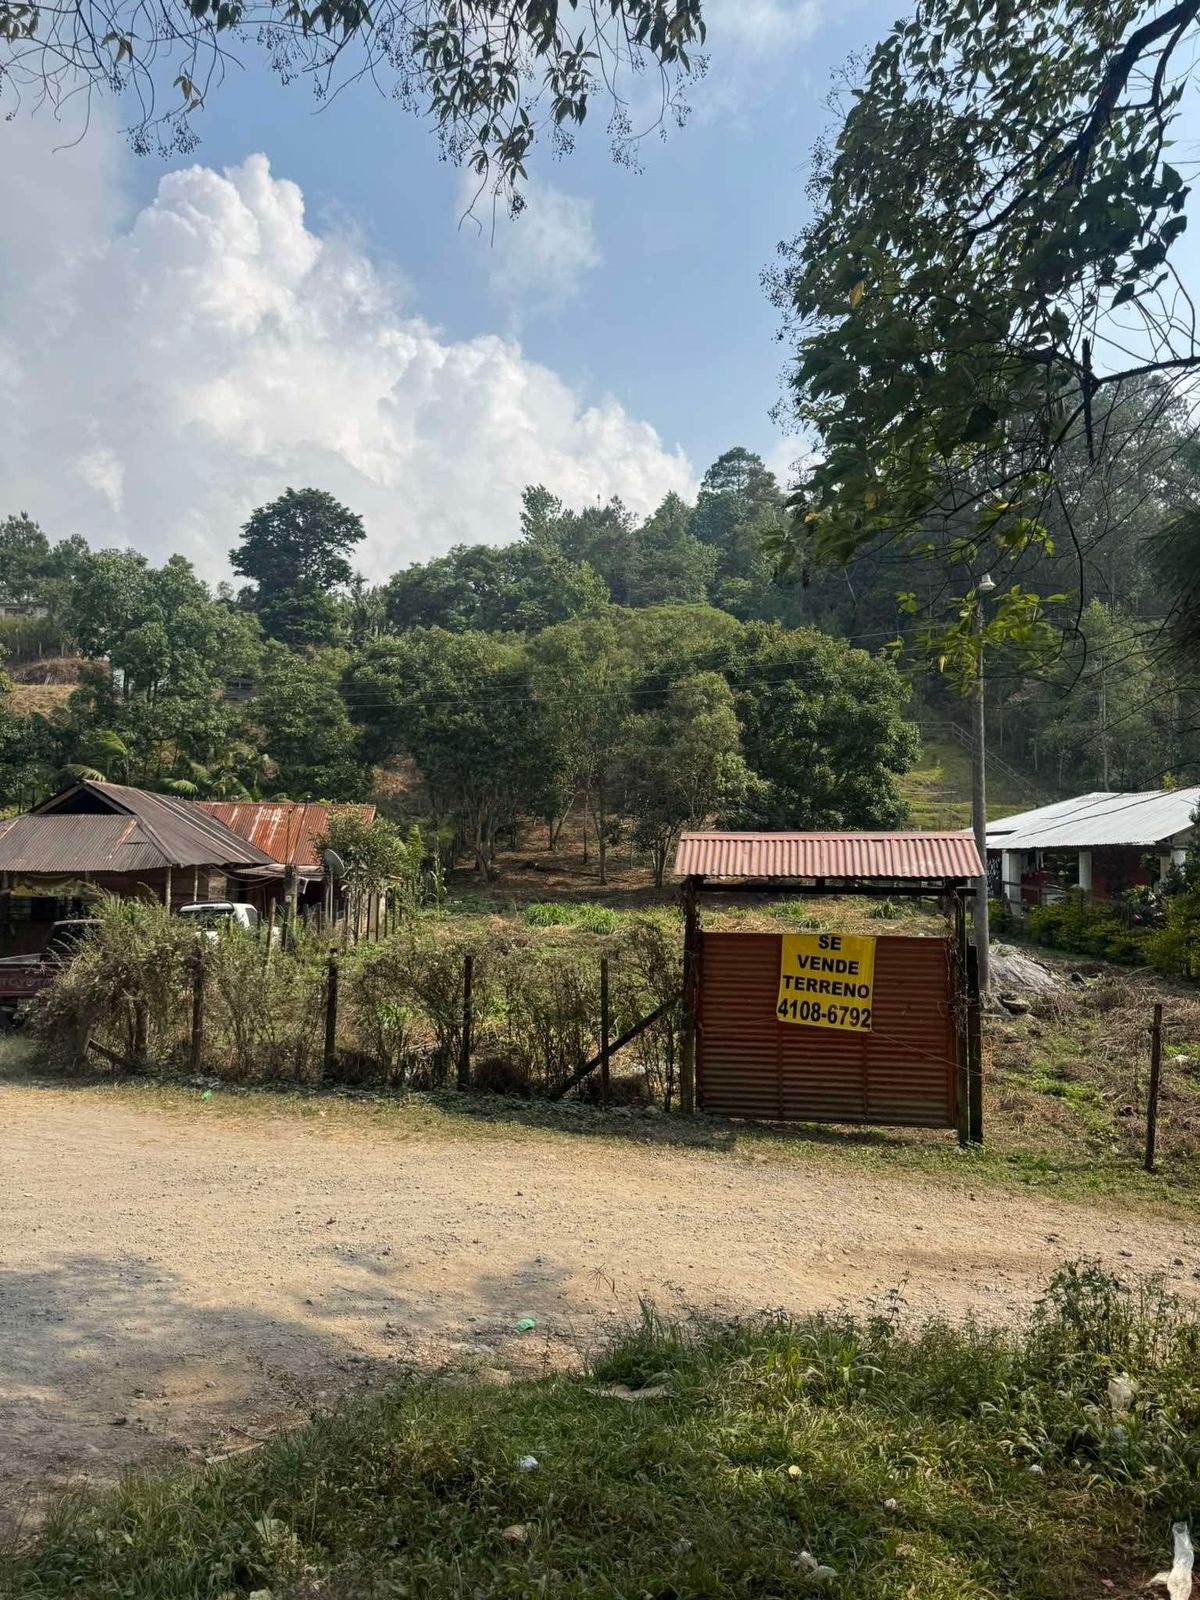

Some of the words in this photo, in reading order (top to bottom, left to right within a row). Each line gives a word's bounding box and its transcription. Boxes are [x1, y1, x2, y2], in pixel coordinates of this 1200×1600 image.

[818, 935, 842, 951] SE
[797, 954, 859, 975] VENDE
[782, 975, 870, 999] TERRENO
[778, 998, 871, 1028] 4108-6792
